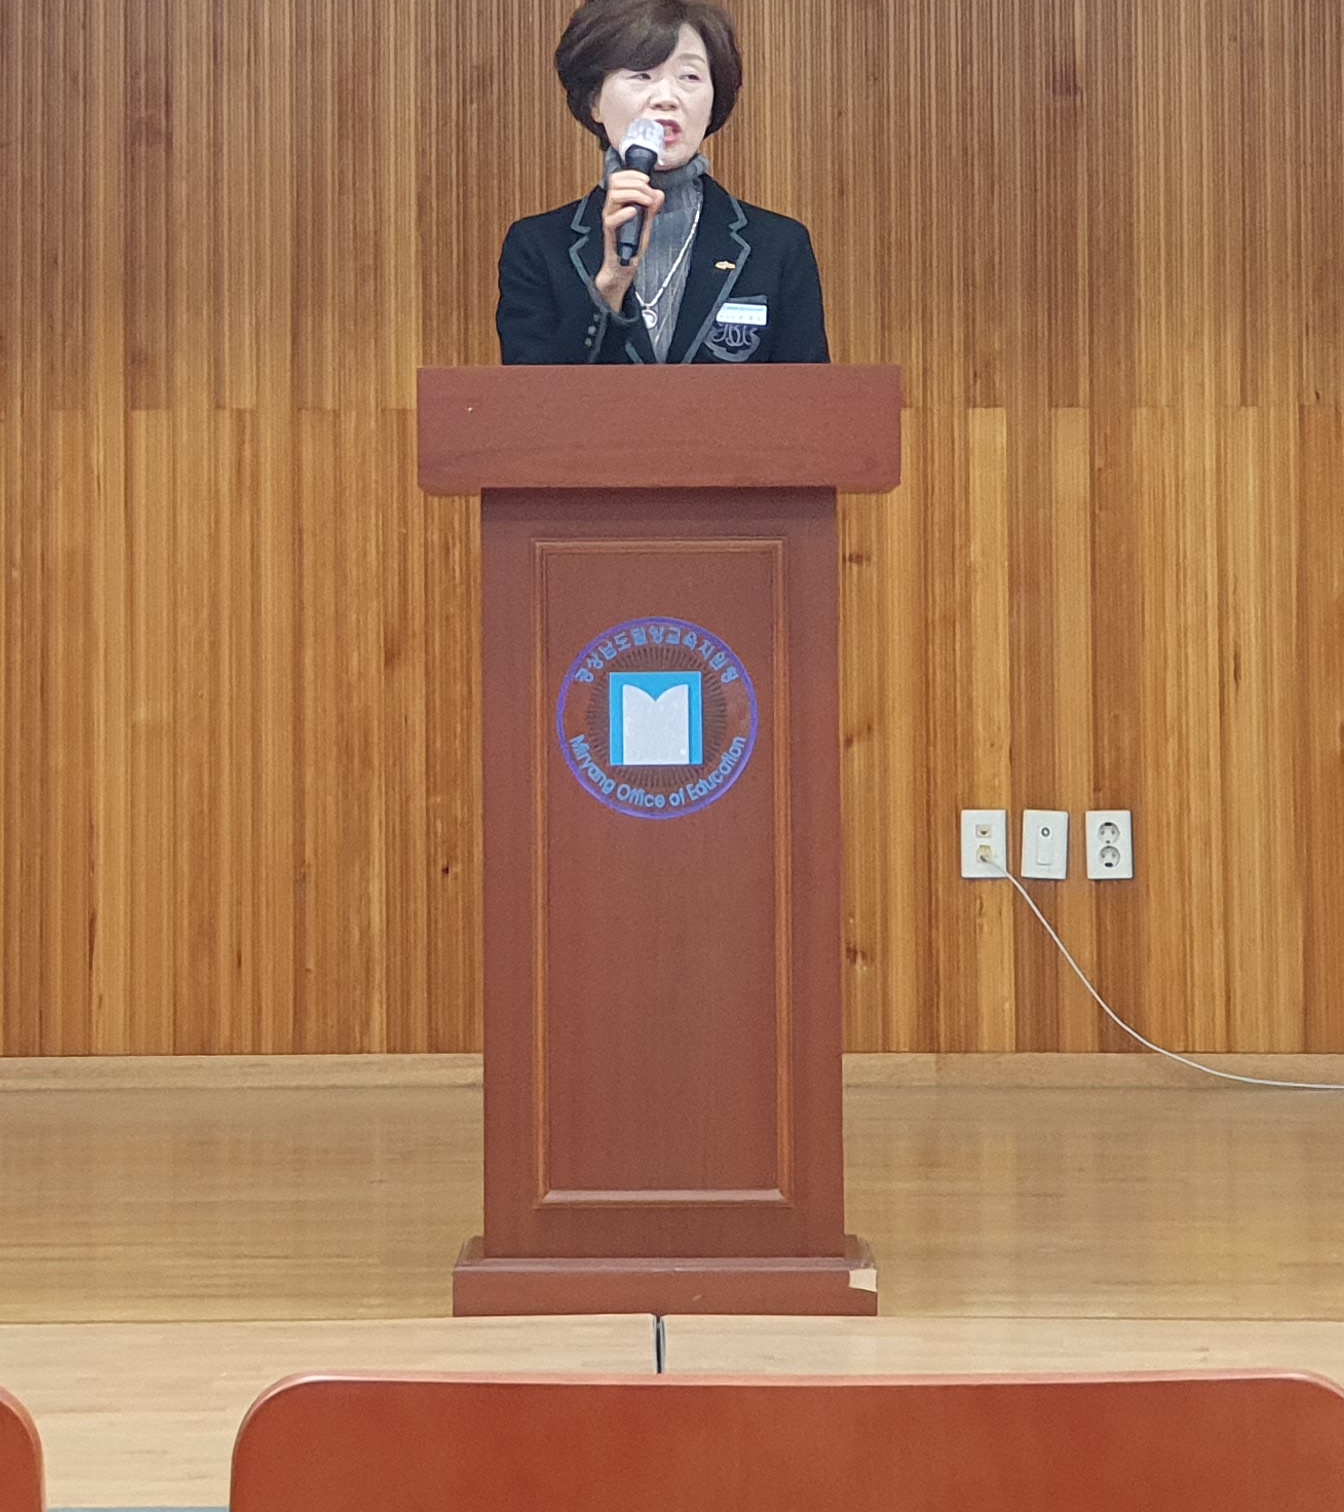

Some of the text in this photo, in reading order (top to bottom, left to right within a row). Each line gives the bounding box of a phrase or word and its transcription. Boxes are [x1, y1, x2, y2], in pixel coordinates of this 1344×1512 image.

[570, 734, 746, 808] Miryang Office of Education
